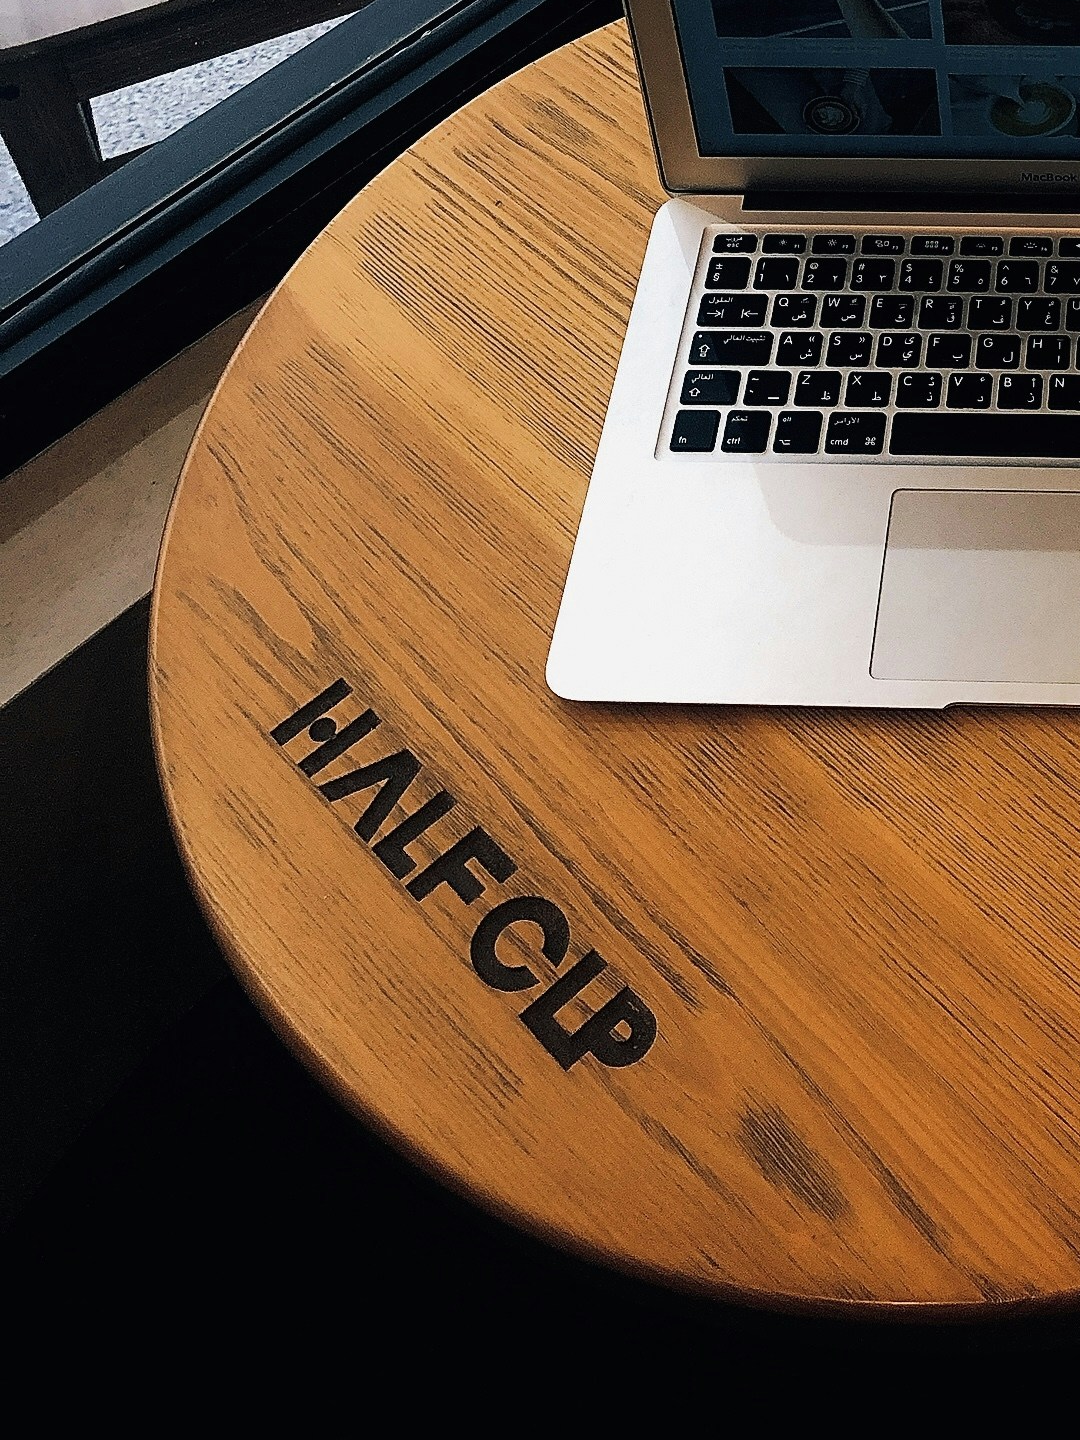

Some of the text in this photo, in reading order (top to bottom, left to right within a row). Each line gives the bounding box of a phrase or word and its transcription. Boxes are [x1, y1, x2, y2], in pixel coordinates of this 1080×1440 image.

[1021, 173, 1078, 182] MacBook
[906, 263, 912, 272] $
[955, 264, 964, 272] %
[1051, 265, 1058, 273] &
[807, 274, 814, 283] 2
[856, 275, 863, 283] 3
[953, 276, 960, 284] 5
[1001, 277, 1008, 285] 6
[1051, 277, 1057, 285] 7
[779, 297, 789, 307] Q
[829, 298, 840, 307] W
[877, 298, 883, 308] E
[926, 299, 933, 308] R
[976, 299, 982, 308] T
[1024, 301, 1032, 310] Y
[1072, 301, 1080, 310] U
[783, 335, 793, 344] A
[833, 336, 841, 345] S
[883, 337, 892, 346] D
[933, 337, 940, 346] F
[983, 338, 993, 347] G
[1033, 339, 1042, 348] H
[802, 375, 811, 385] Z
[852, 375, 862, 385] X
[904, 376, 912, 386] C
[954, 377, 963, 386] V
[1004, 377, 1012, 387] B
[1055, 378, 1064, 388] N
